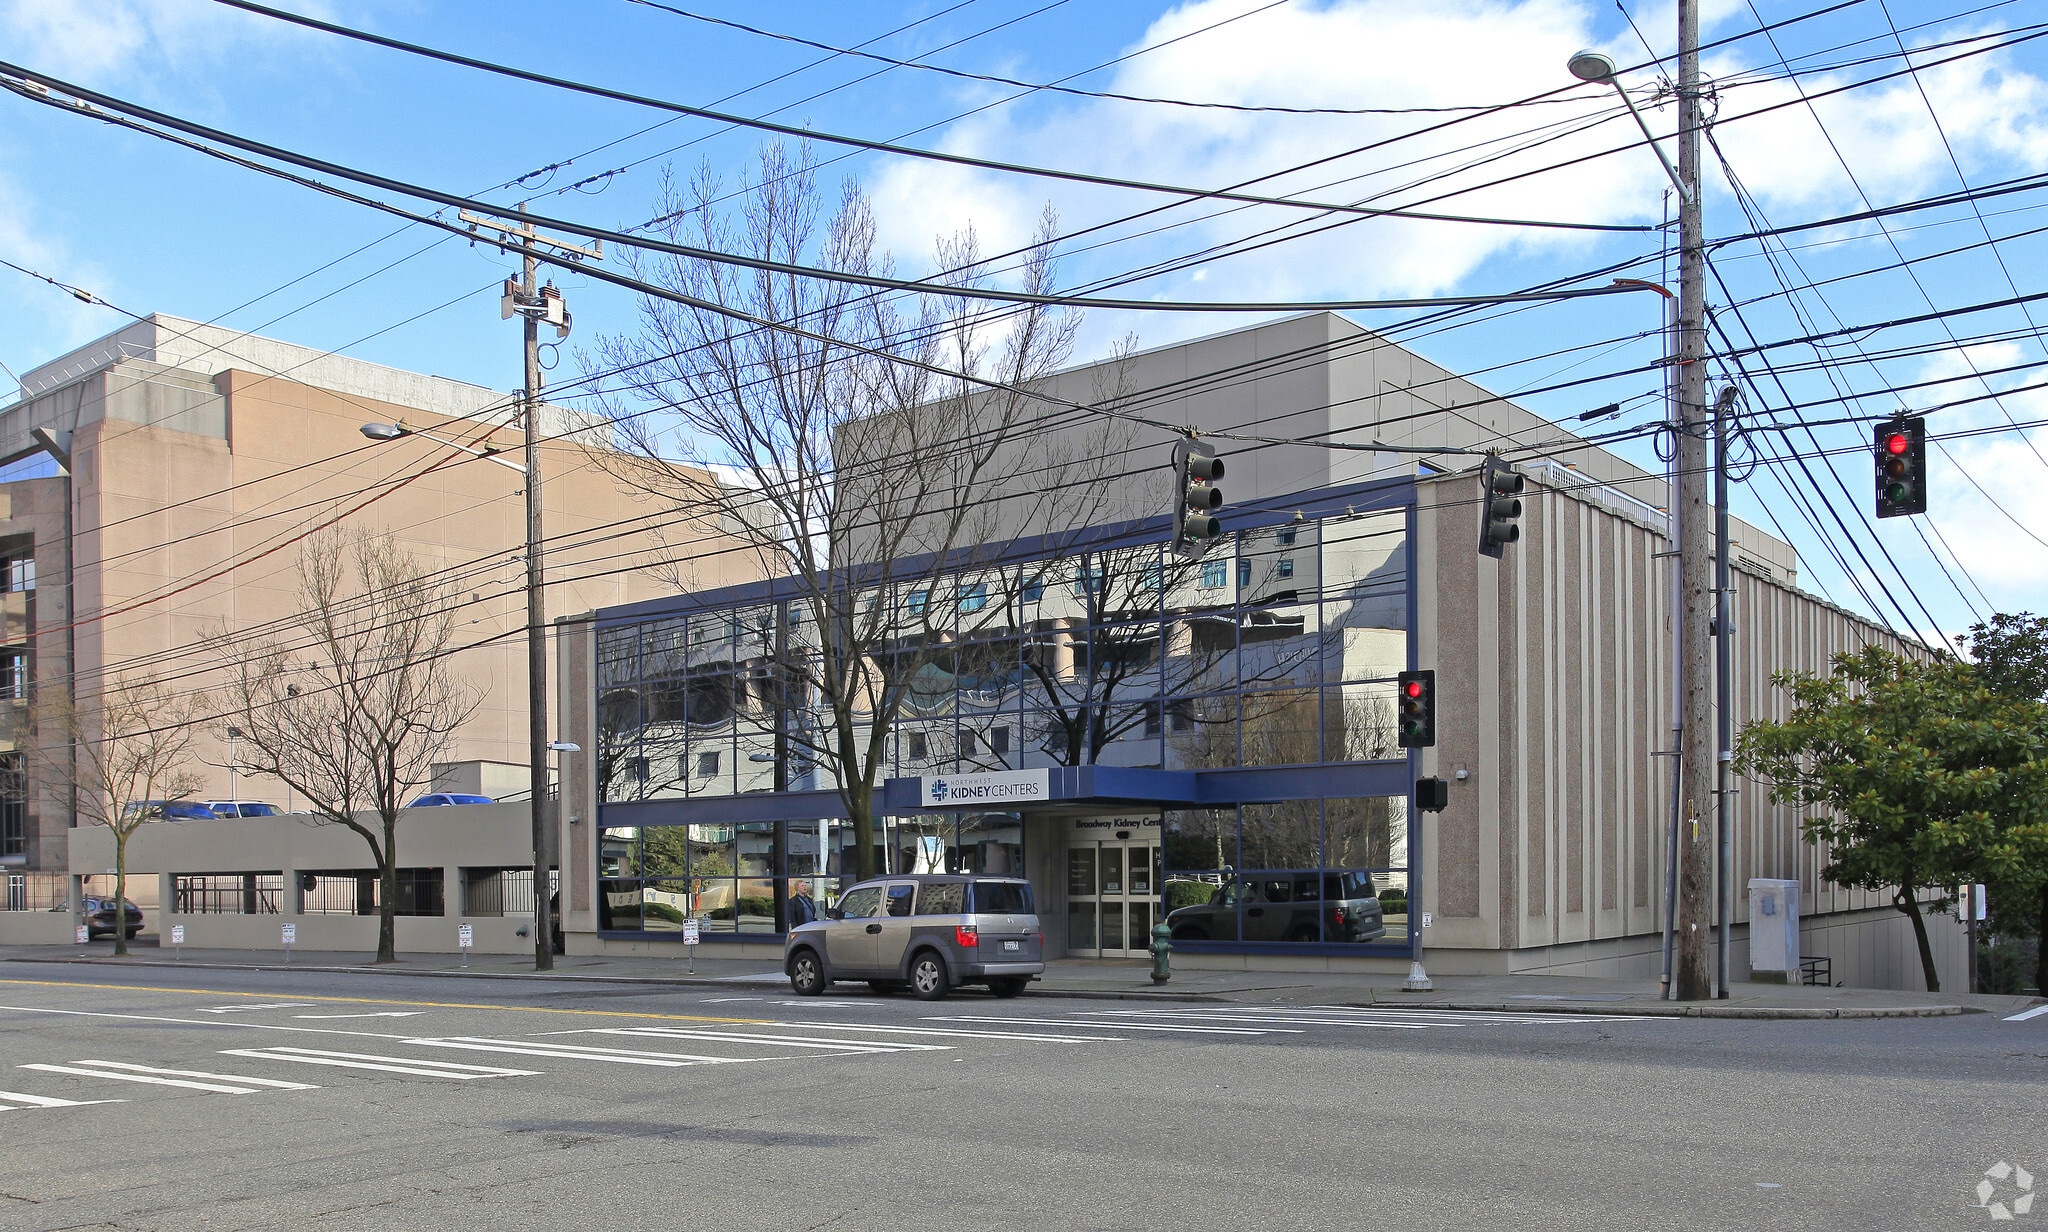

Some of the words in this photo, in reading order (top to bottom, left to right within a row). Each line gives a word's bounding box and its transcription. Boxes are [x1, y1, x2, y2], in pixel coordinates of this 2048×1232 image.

[950, 777, 992, 786] NORTHWEST
[1075, 819, 1112, 829] Broadway
[1114, 818, 1141, 828] Kidney
